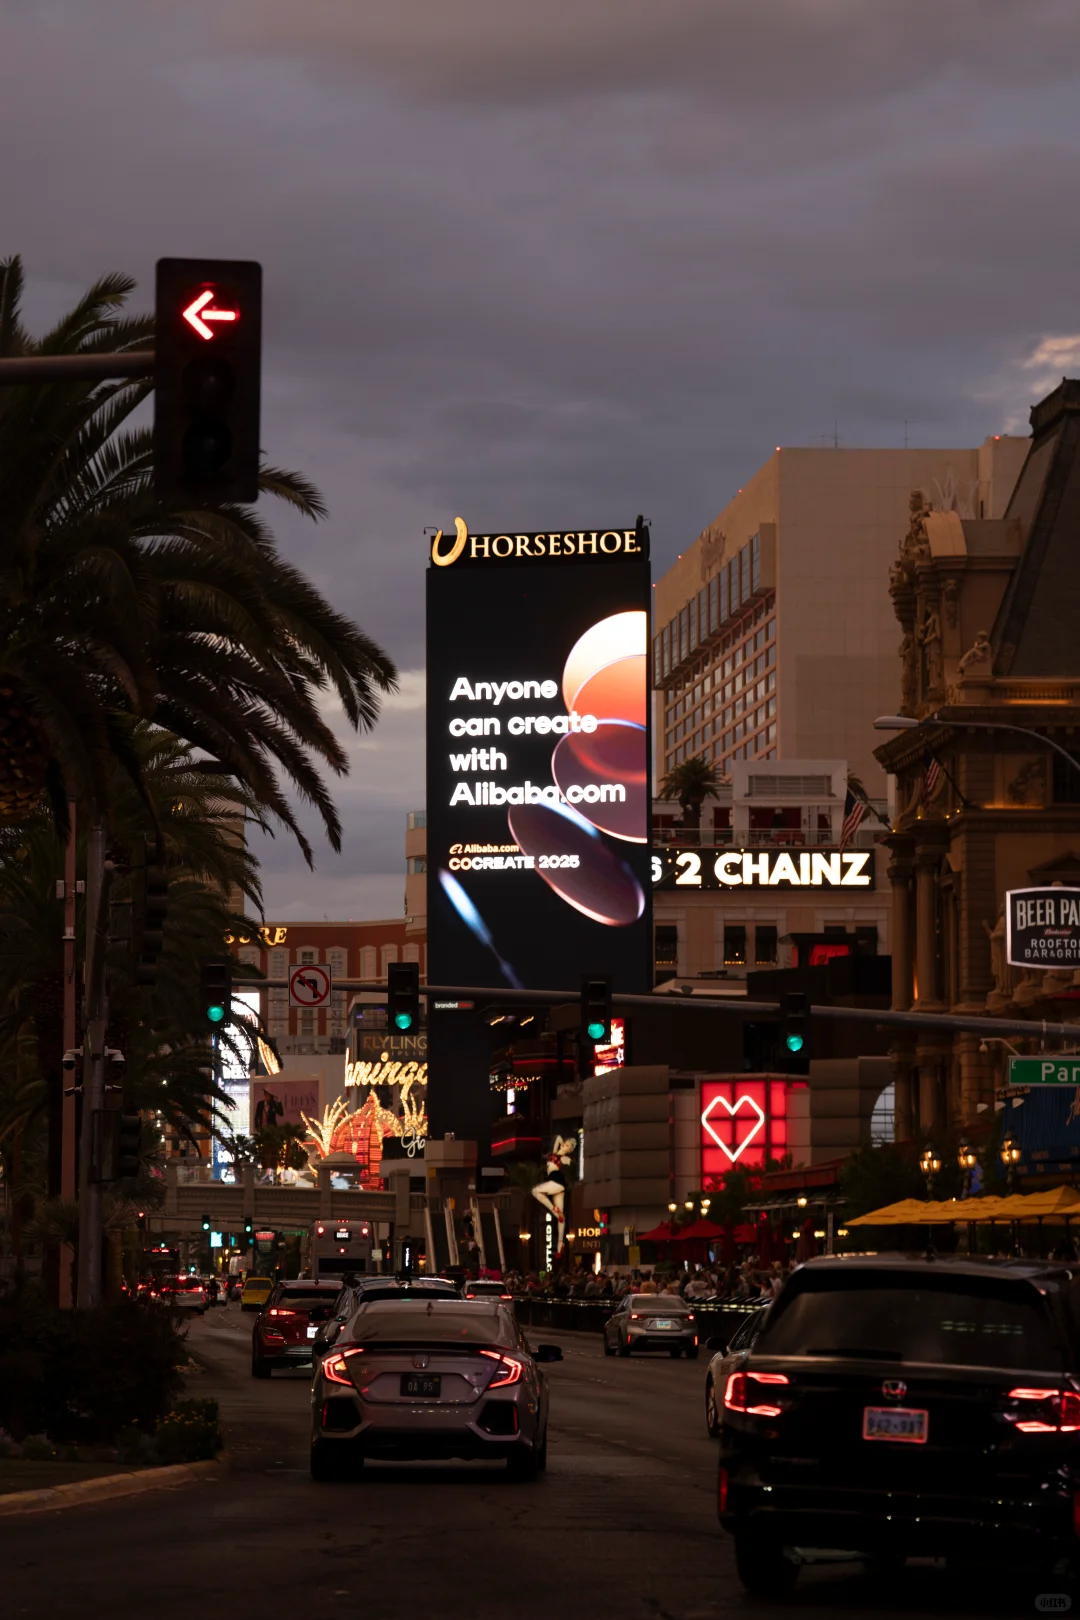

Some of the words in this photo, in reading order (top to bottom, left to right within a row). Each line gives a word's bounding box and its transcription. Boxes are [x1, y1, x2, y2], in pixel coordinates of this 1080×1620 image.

[449, 677, 558, 705] Anyone
[449, 717, 500, 736] can
[508, 711, 598, 734] create
[449, 748, 508, 771] with
[449, 781, 626, 806] Alibaba.com
[464, 844, 519, 853] Alibaba.com
[449, 857, 535, 870] COCREATE
[538, 855, 580, 868] 2025
[676, 852, 701, 884] 2
[714, 852, 870, 885] CHAINZ
[1016, 899, 1055, 931] BEER
[1060, 898, 1080, 926] PA
[1031, 939, 1080, 948] ROOFTO
[582, 1240, 601, 1249] ENT
